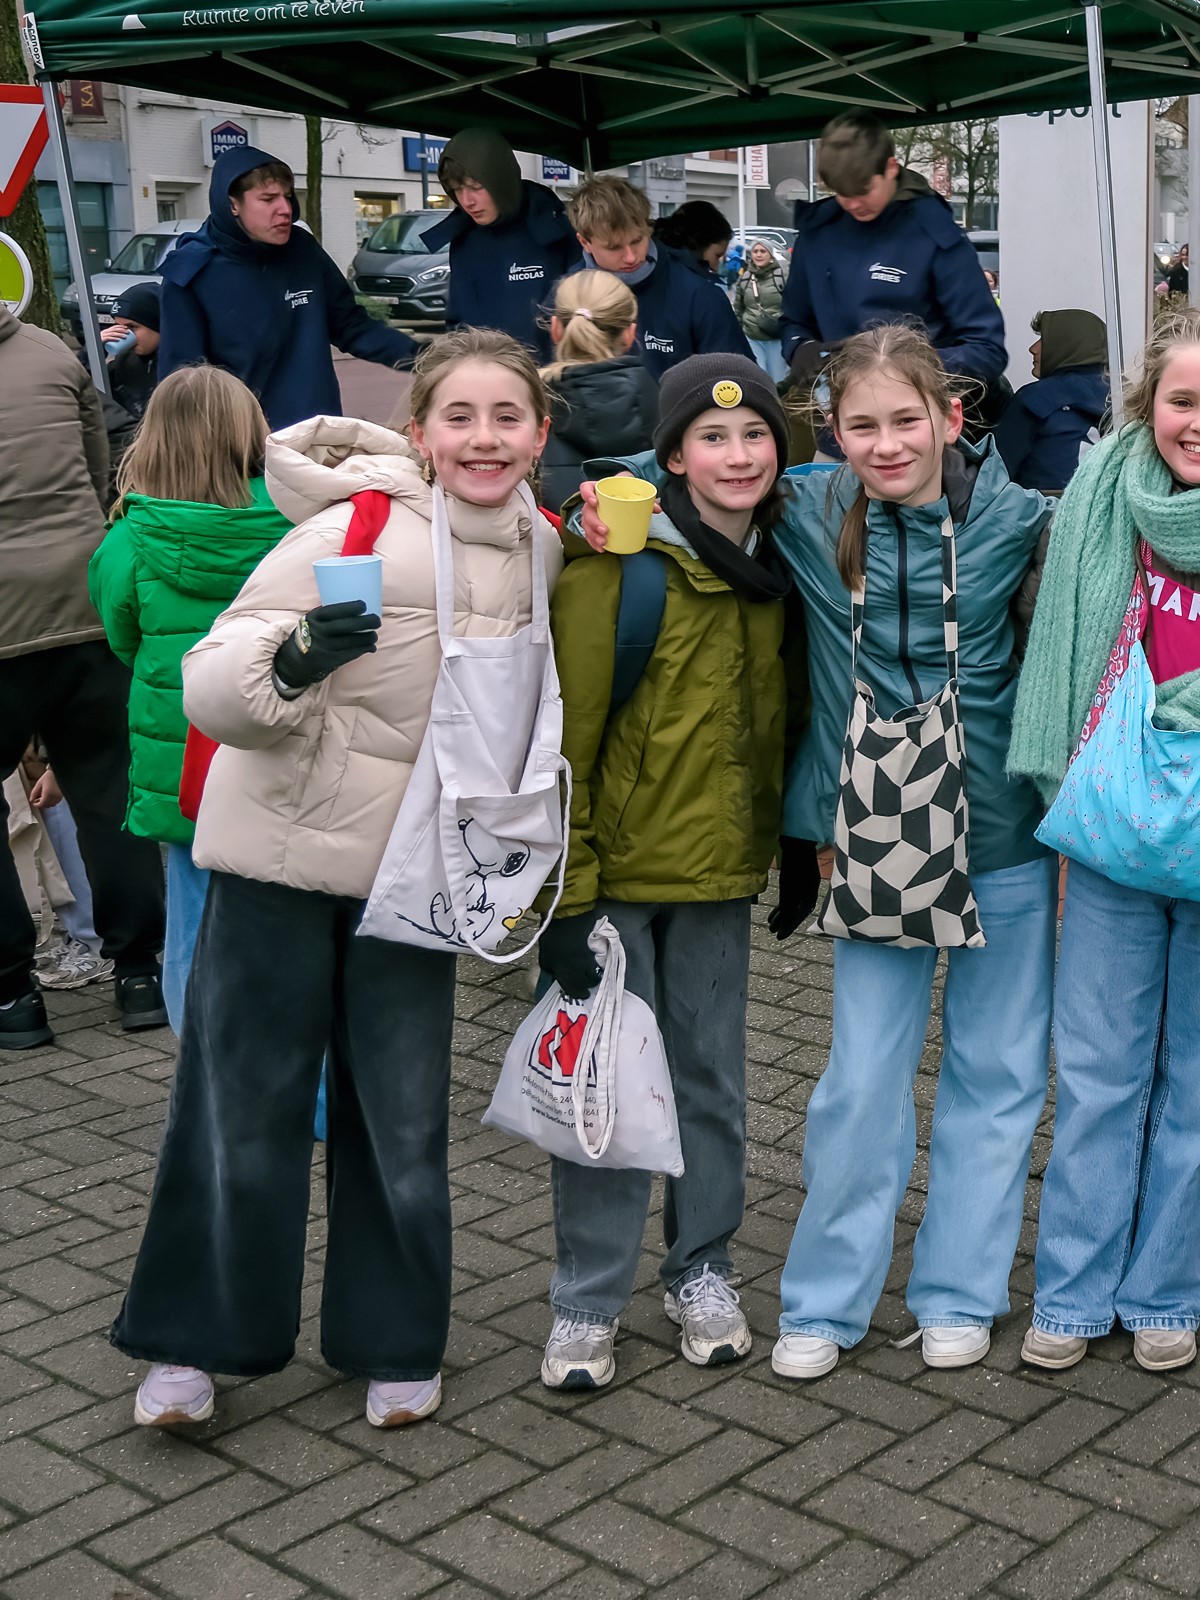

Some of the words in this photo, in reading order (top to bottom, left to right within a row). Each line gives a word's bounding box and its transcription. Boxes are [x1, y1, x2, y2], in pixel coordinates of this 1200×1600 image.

[183, 9, 249, 26] Ruimte
[255, 4, 286, 21] om
[291, 2, 308, 18] te
[315, 0, 365, 16] leven
[80, 80, 94, 107] KA
[1026, 103, 1121, 125] pot
[213, 134, 246, 144] IMMO
[543, 167, 569, 175] POINT
[508, 271, 544, 281] NICOLAS
